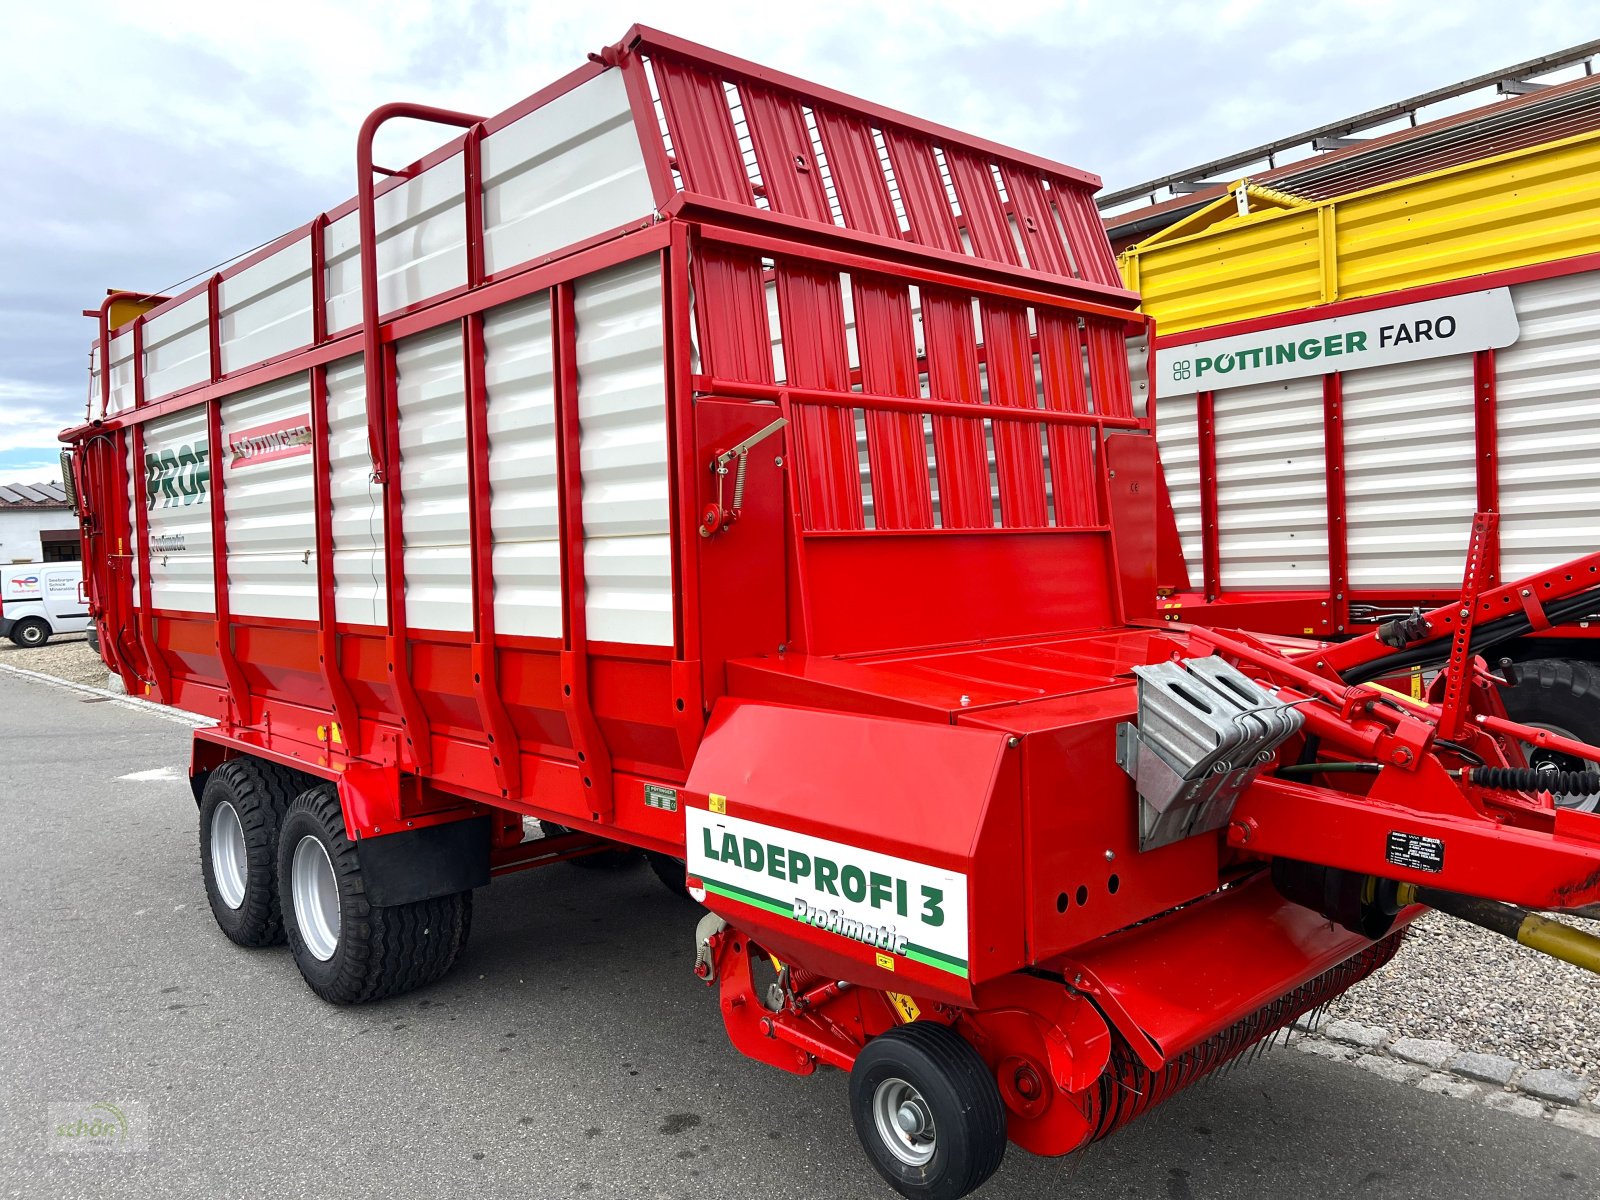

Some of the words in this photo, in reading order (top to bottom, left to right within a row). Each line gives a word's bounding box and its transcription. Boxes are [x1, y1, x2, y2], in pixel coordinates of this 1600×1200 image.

[1195, 330, 1368, 377] PÖTTINGER
[1379, 315, 1456, 348] FARO
[702, 826, 908, 918] LADEPROFI
[920, 884, 945, 927] 3
[792, 897, 909, 957] Profimatic
